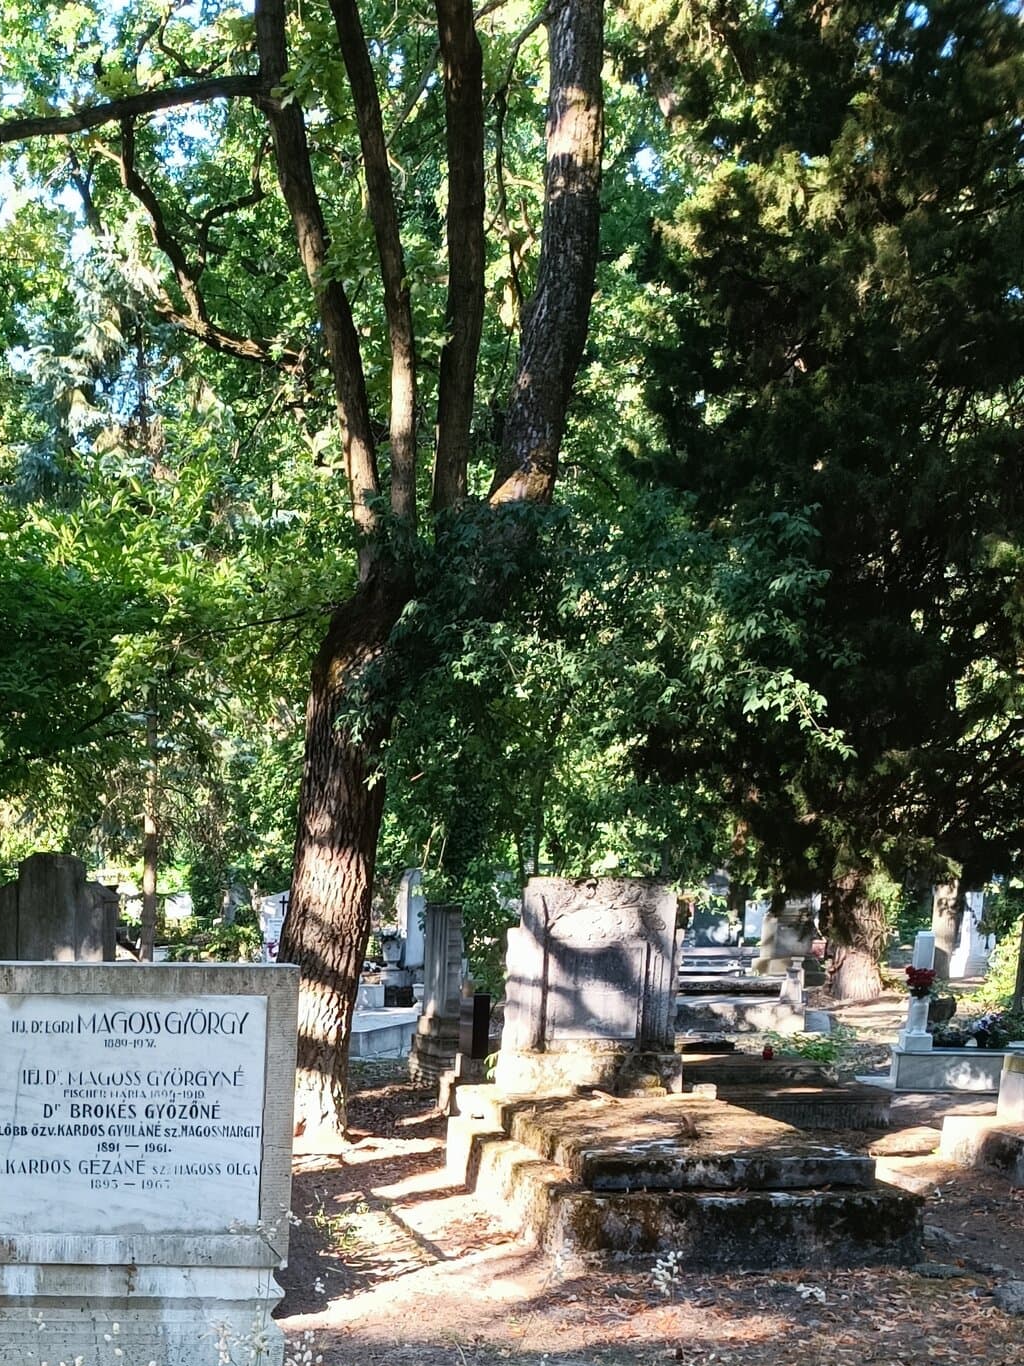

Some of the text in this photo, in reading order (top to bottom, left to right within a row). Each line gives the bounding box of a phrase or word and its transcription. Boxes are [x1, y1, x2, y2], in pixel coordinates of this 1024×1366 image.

[77, 1011, 161, 1035] MAGOSS
[164, 1008, 250, 1035] GYÖRGY
[22, 1069, 44, 1085] IFJ.
[68, 1071, 142, 1087] MAGOSS
[147, 1064, 245, 1087] GYÖRGYNÉ
[63, 1089, 107, 1099] FISCHER
[70, 1100, 137, 1119] BROKÉS
[57, 1124, 106, 1137] KARDOS
[108, 1121, 162, 1138] GYULÁNÉ
[97, 1142, 120, 1153] 1891
[5, 1160, 72, 1175] KARDOS
[78, 1154, 146, 1175] GÉZÁNÉ
[226, 1163, 258, 1176] OLGA
